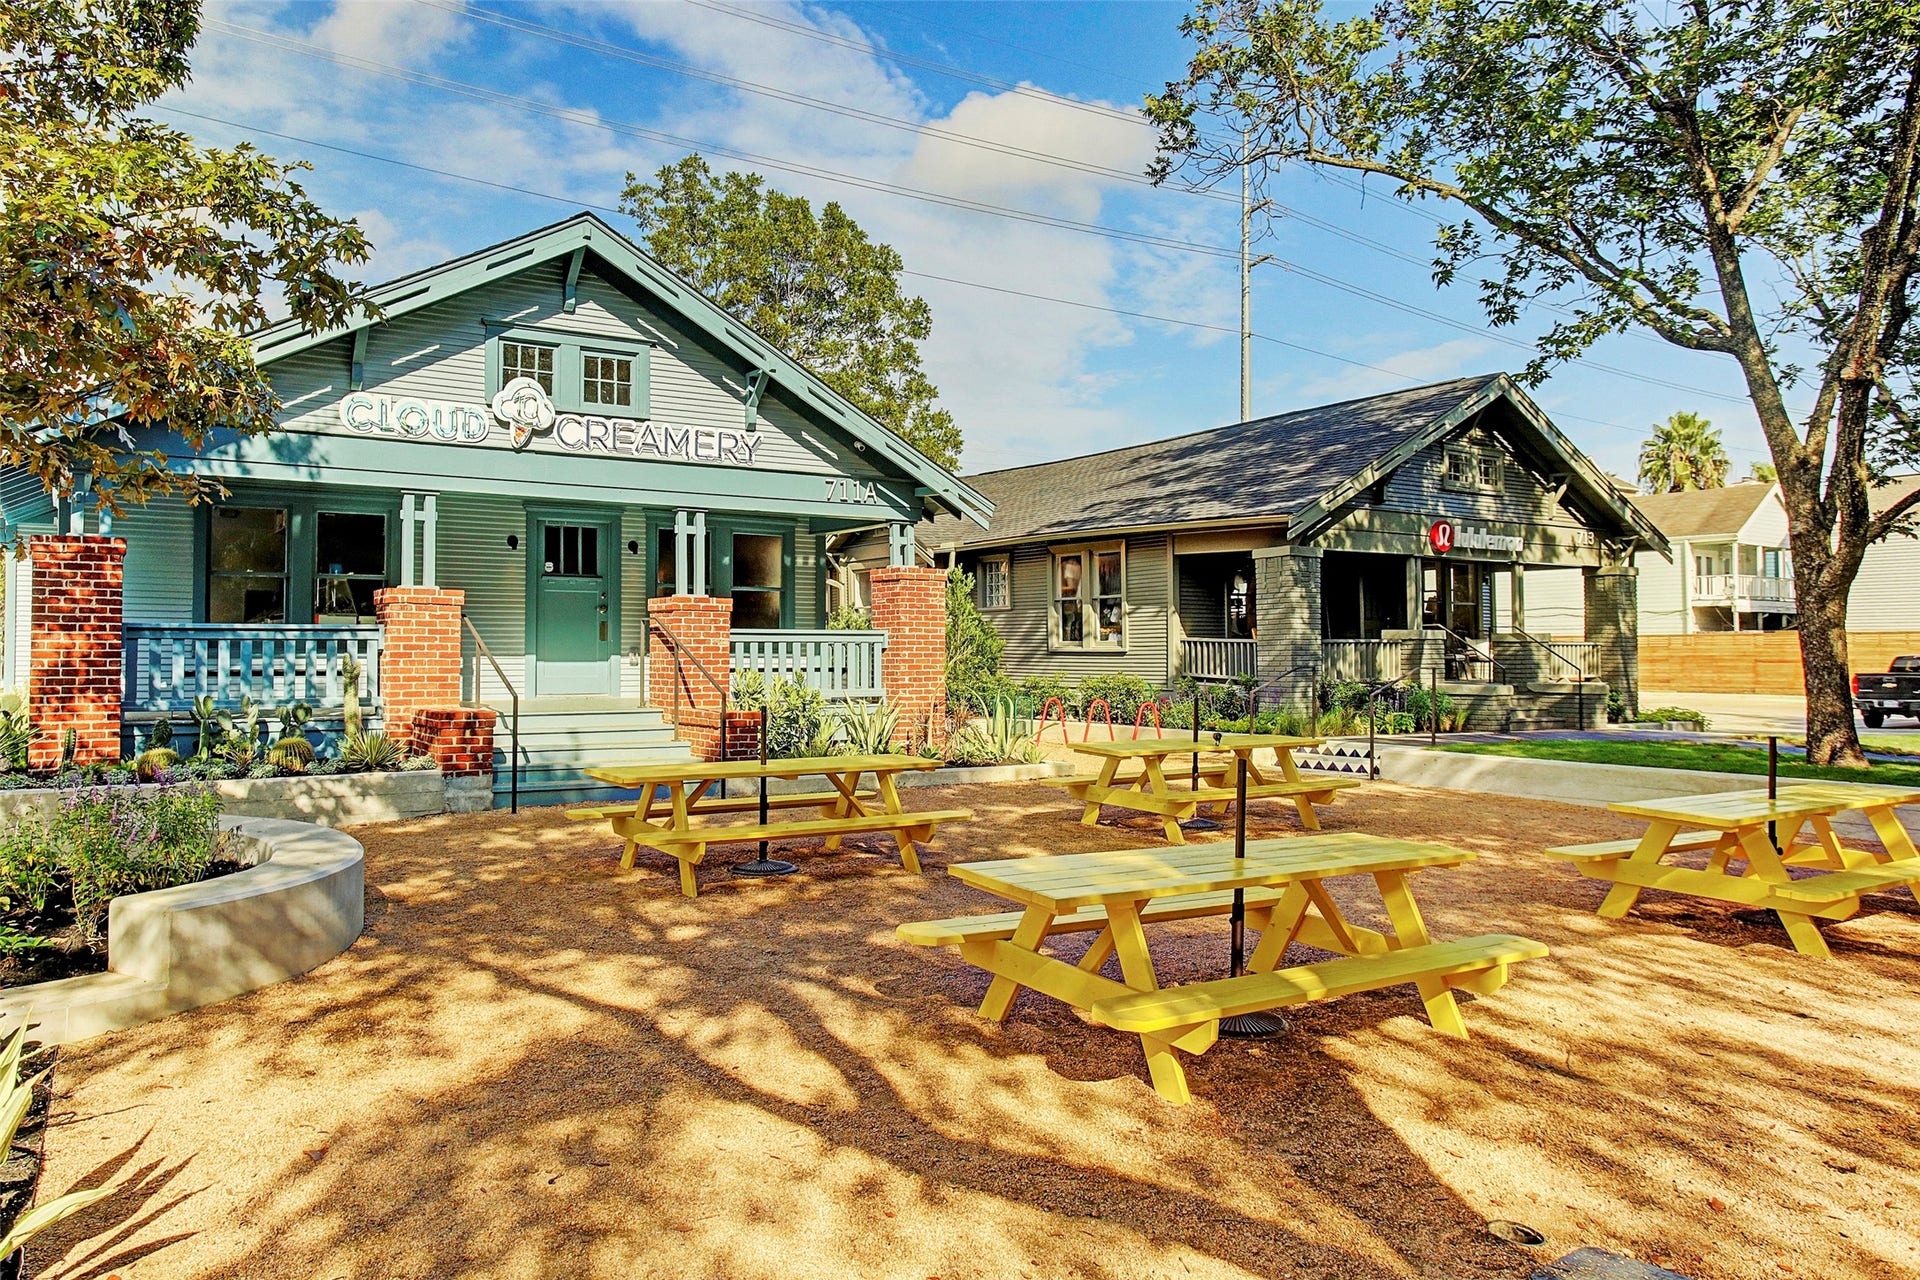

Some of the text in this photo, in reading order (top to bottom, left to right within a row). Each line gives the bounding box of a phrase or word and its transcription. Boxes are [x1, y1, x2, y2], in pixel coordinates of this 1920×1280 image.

[340, 393, 488, 441] CLOUD
[554, 414, 764, 465] CREAMERY
[825, 479, 877, 504] 711A
[1453, 525, 1524, 552] lululemon
[1577, 530, 1595, 547] 713
